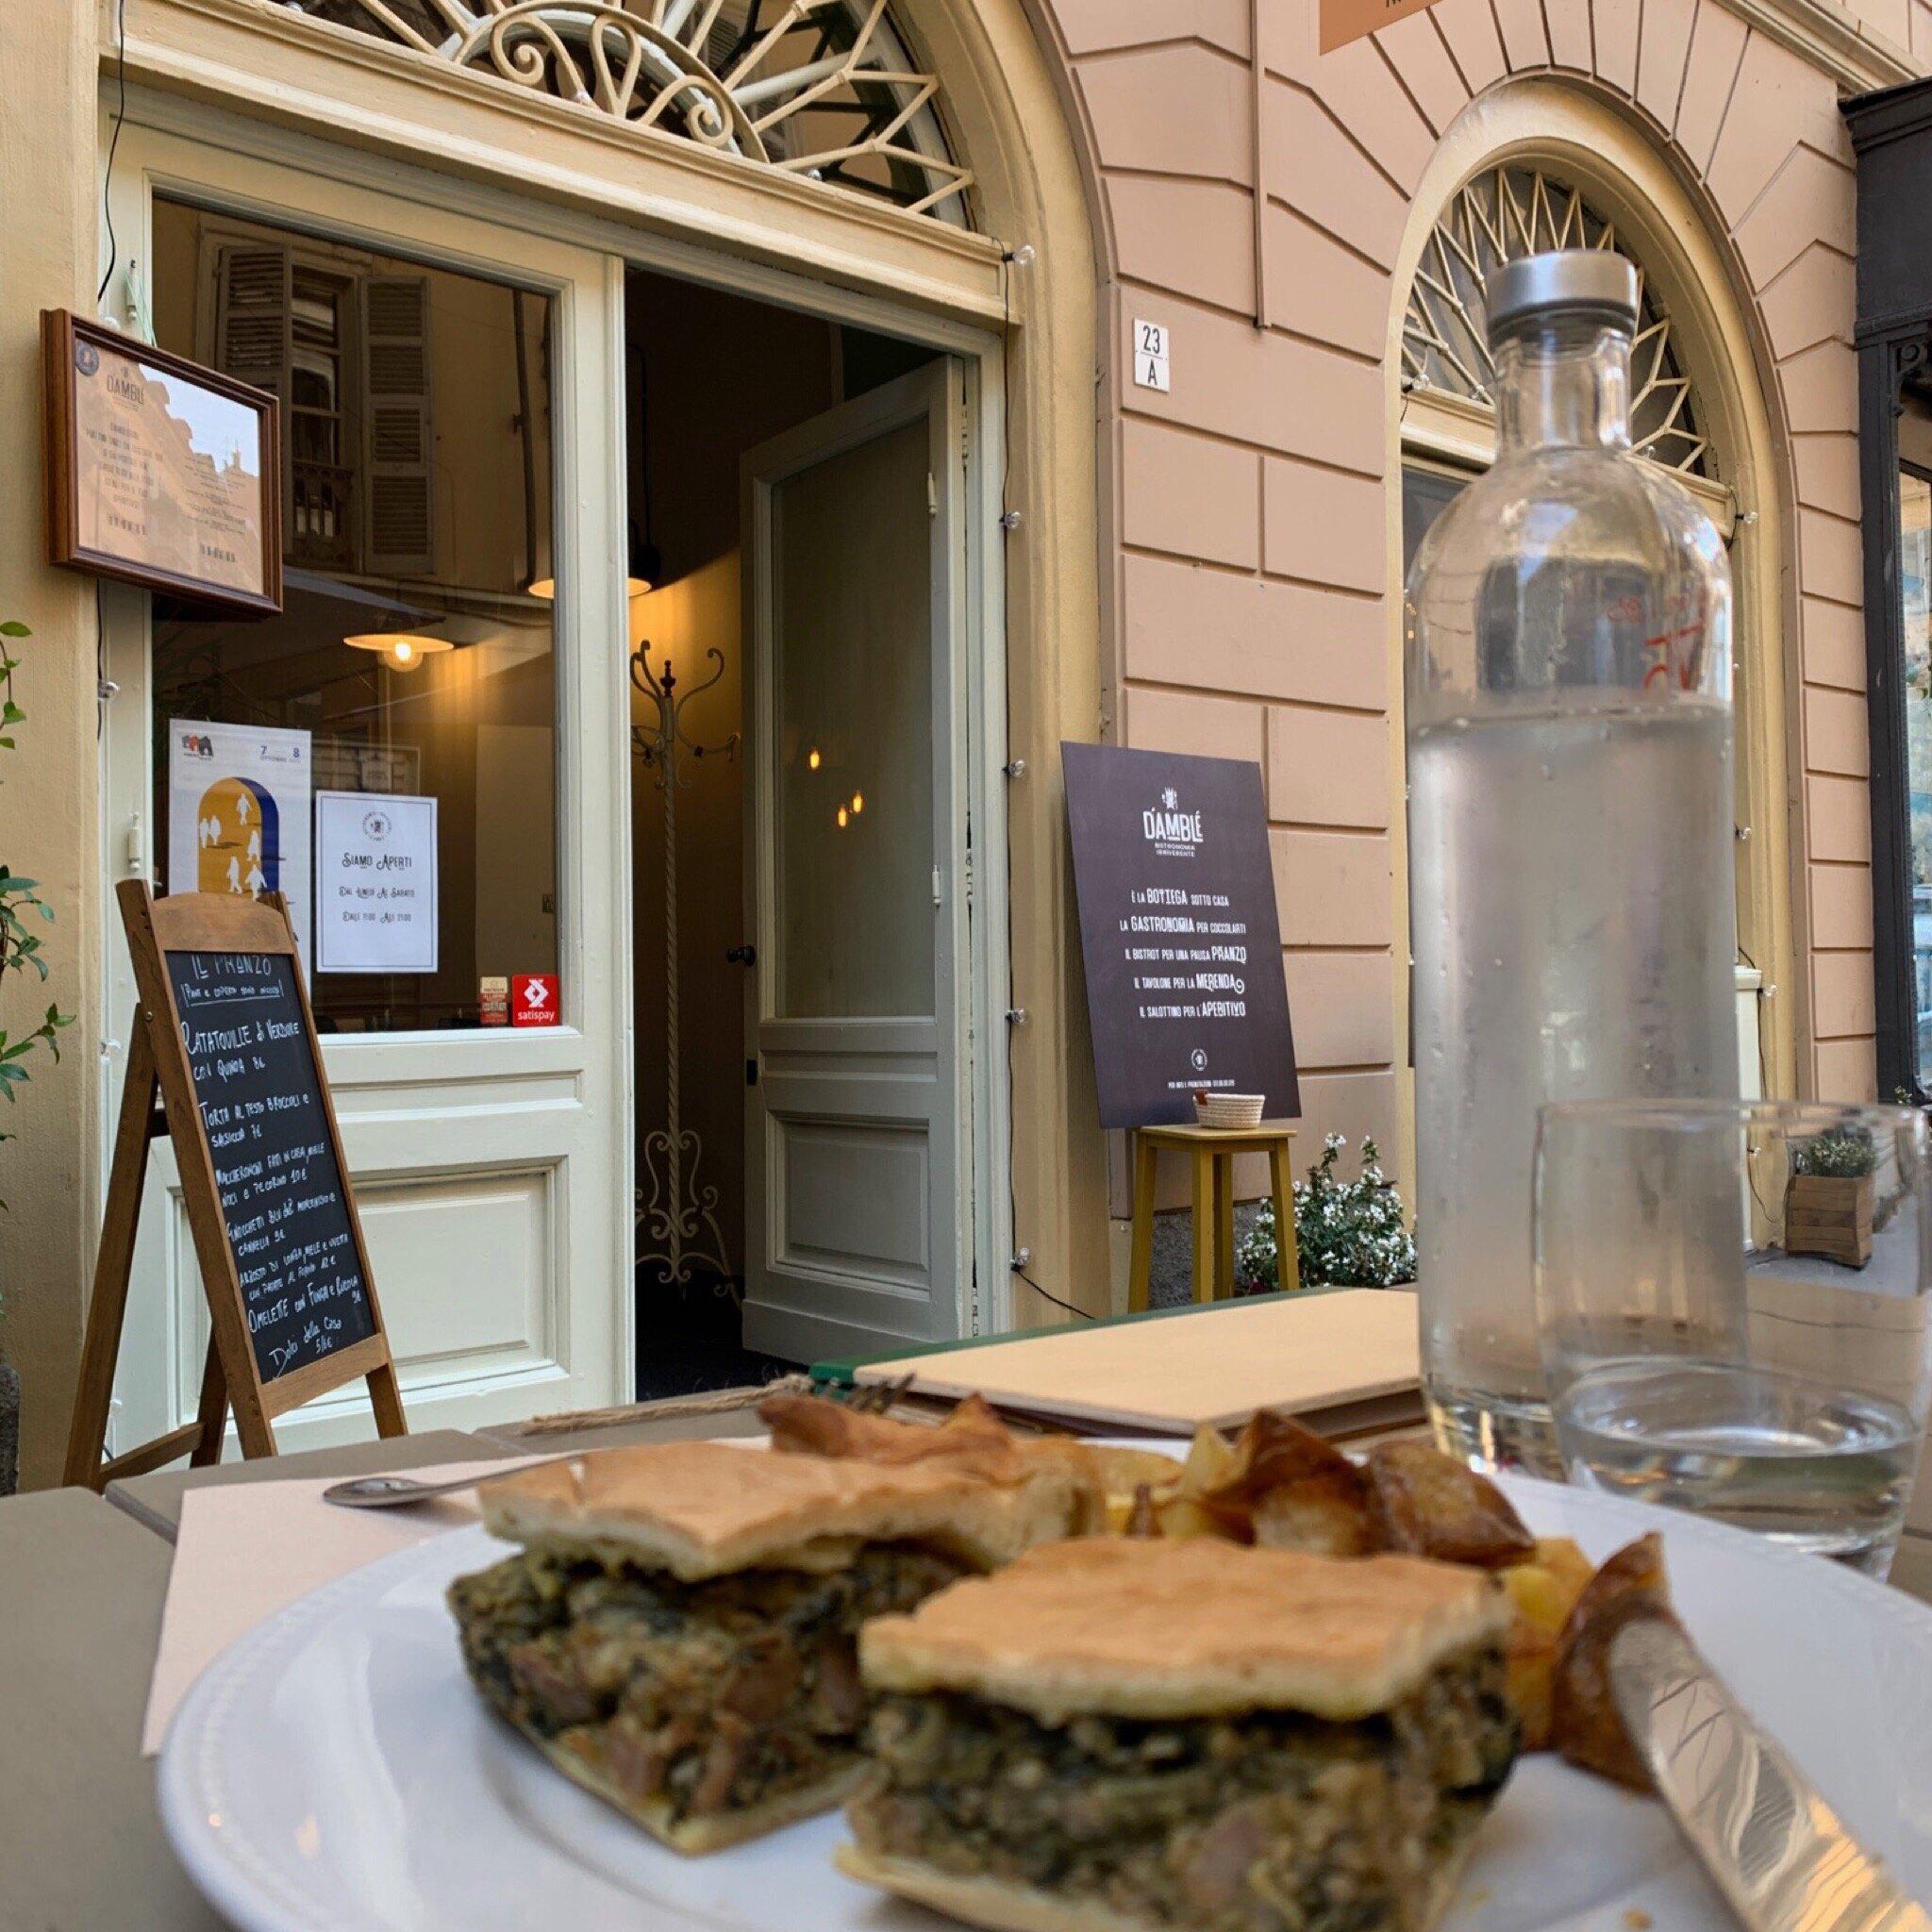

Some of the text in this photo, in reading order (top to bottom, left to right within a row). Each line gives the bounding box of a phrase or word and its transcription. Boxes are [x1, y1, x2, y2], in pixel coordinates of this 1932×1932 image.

[1143, 325, 1160, 354] 23
[1147, 358, 1158, 385] A
[1147, 888, 1188, 906] BOTTEGA
[1191, 894, 1211, 906] SOTTO
[1212, 895, 1229, 907] CASA
[1120, 920, 1129, 931] LA
[1131, 916, 1194, 932] GASTRONOMIA
[1196, 923, 1208, 933] PER
[1132, 949, 1159, 960] BISTROT
[1162, 950, 1174, 960] PER
[1175, 950, 1189, 960] UNA
[1191, 951, 1211, 961] PAUSA
[1211, 946, 1247, 963] PRANZO
[192, 955, 272, 980] IL PRANZO
[1174, 977, 1185, 989] PER
[1187, 978, 1195, 989] LA
[1196, 974, 1237, 991] MERENDA
[518, 1010, 555, 1022] satispay
[1183, 1007, 1196, 1017] PER
